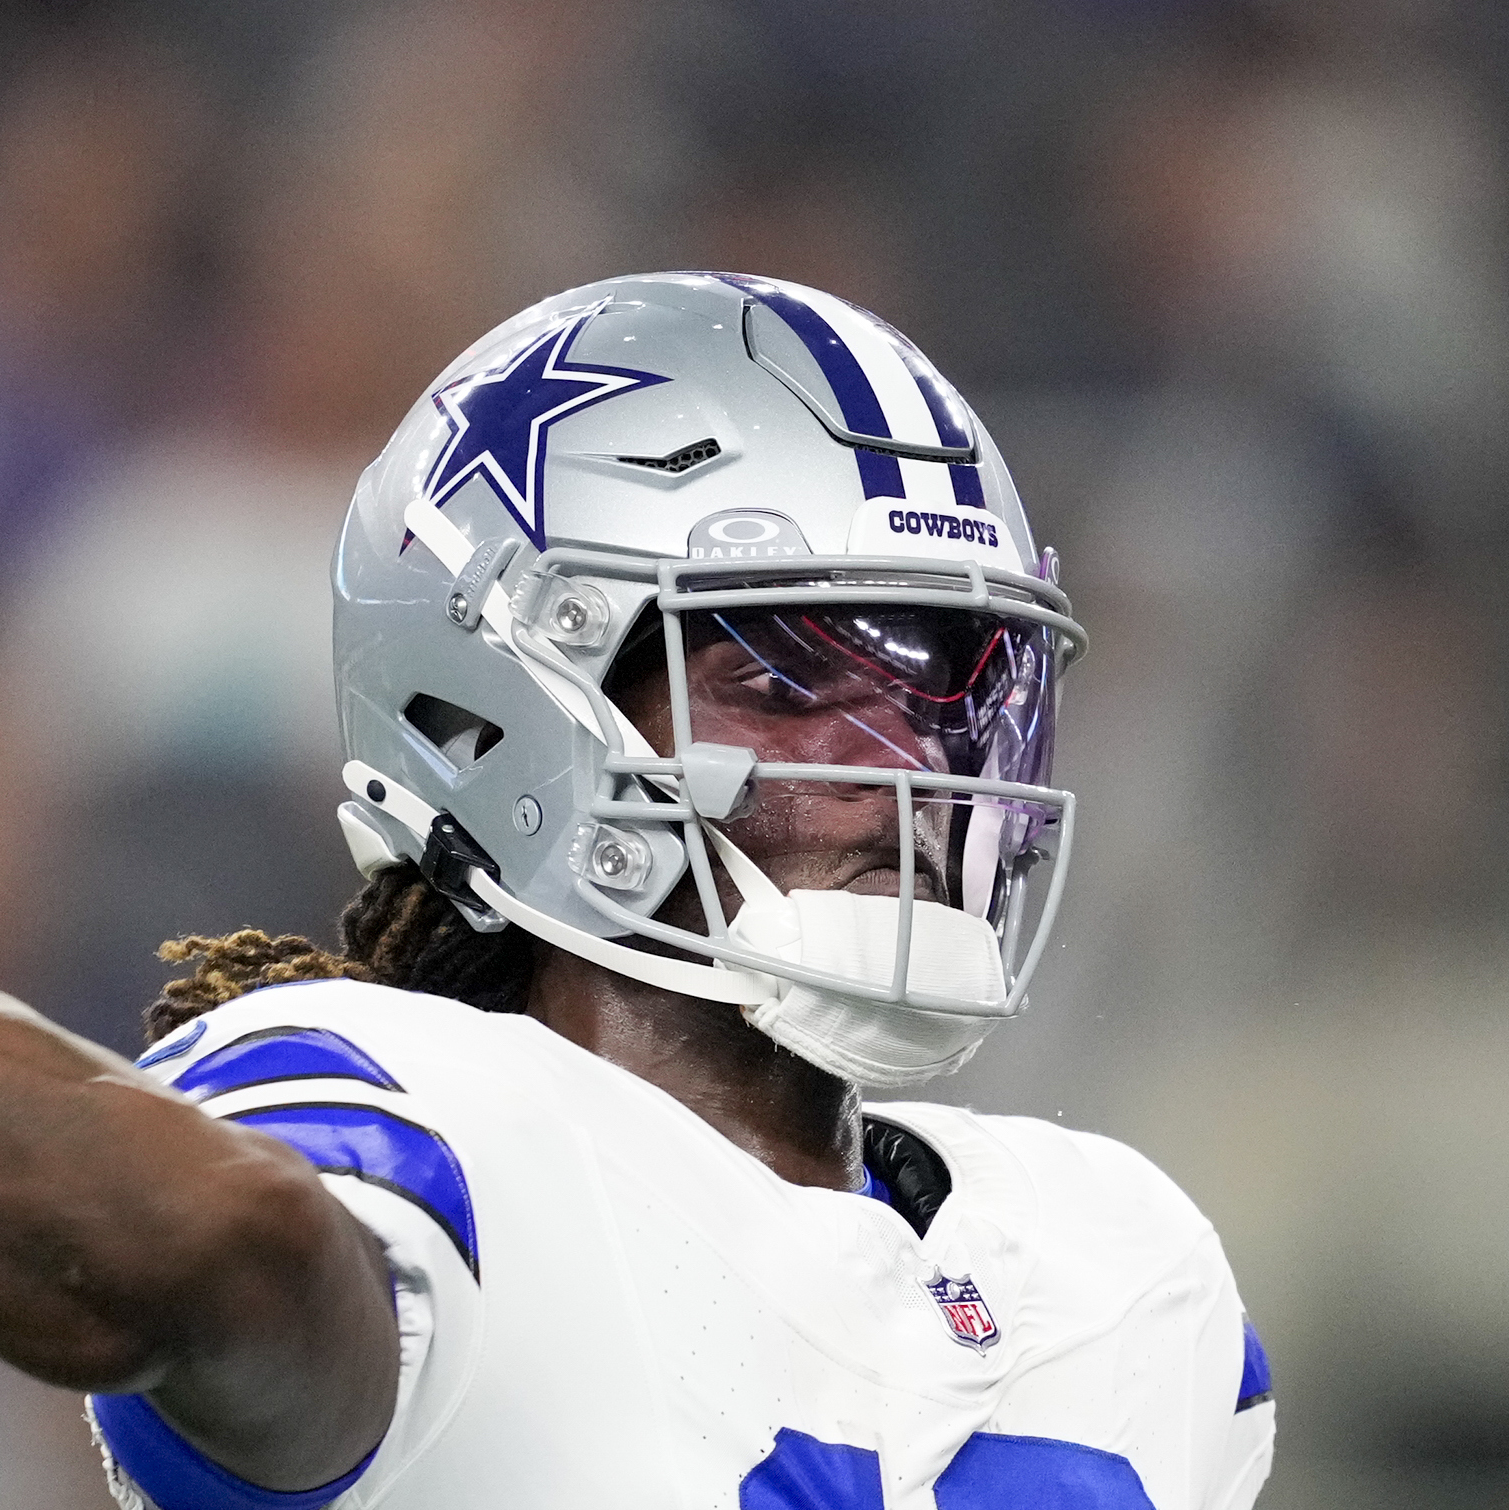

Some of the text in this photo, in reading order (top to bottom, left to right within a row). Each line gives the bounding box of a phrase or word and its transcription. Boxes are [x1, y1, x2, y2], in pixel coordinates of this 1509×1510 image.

[888, 510, 999, 548] COWBOYS
[692, 546, 797, 560] OAKLEY
[943, 1303, 993, 1338] NFL
